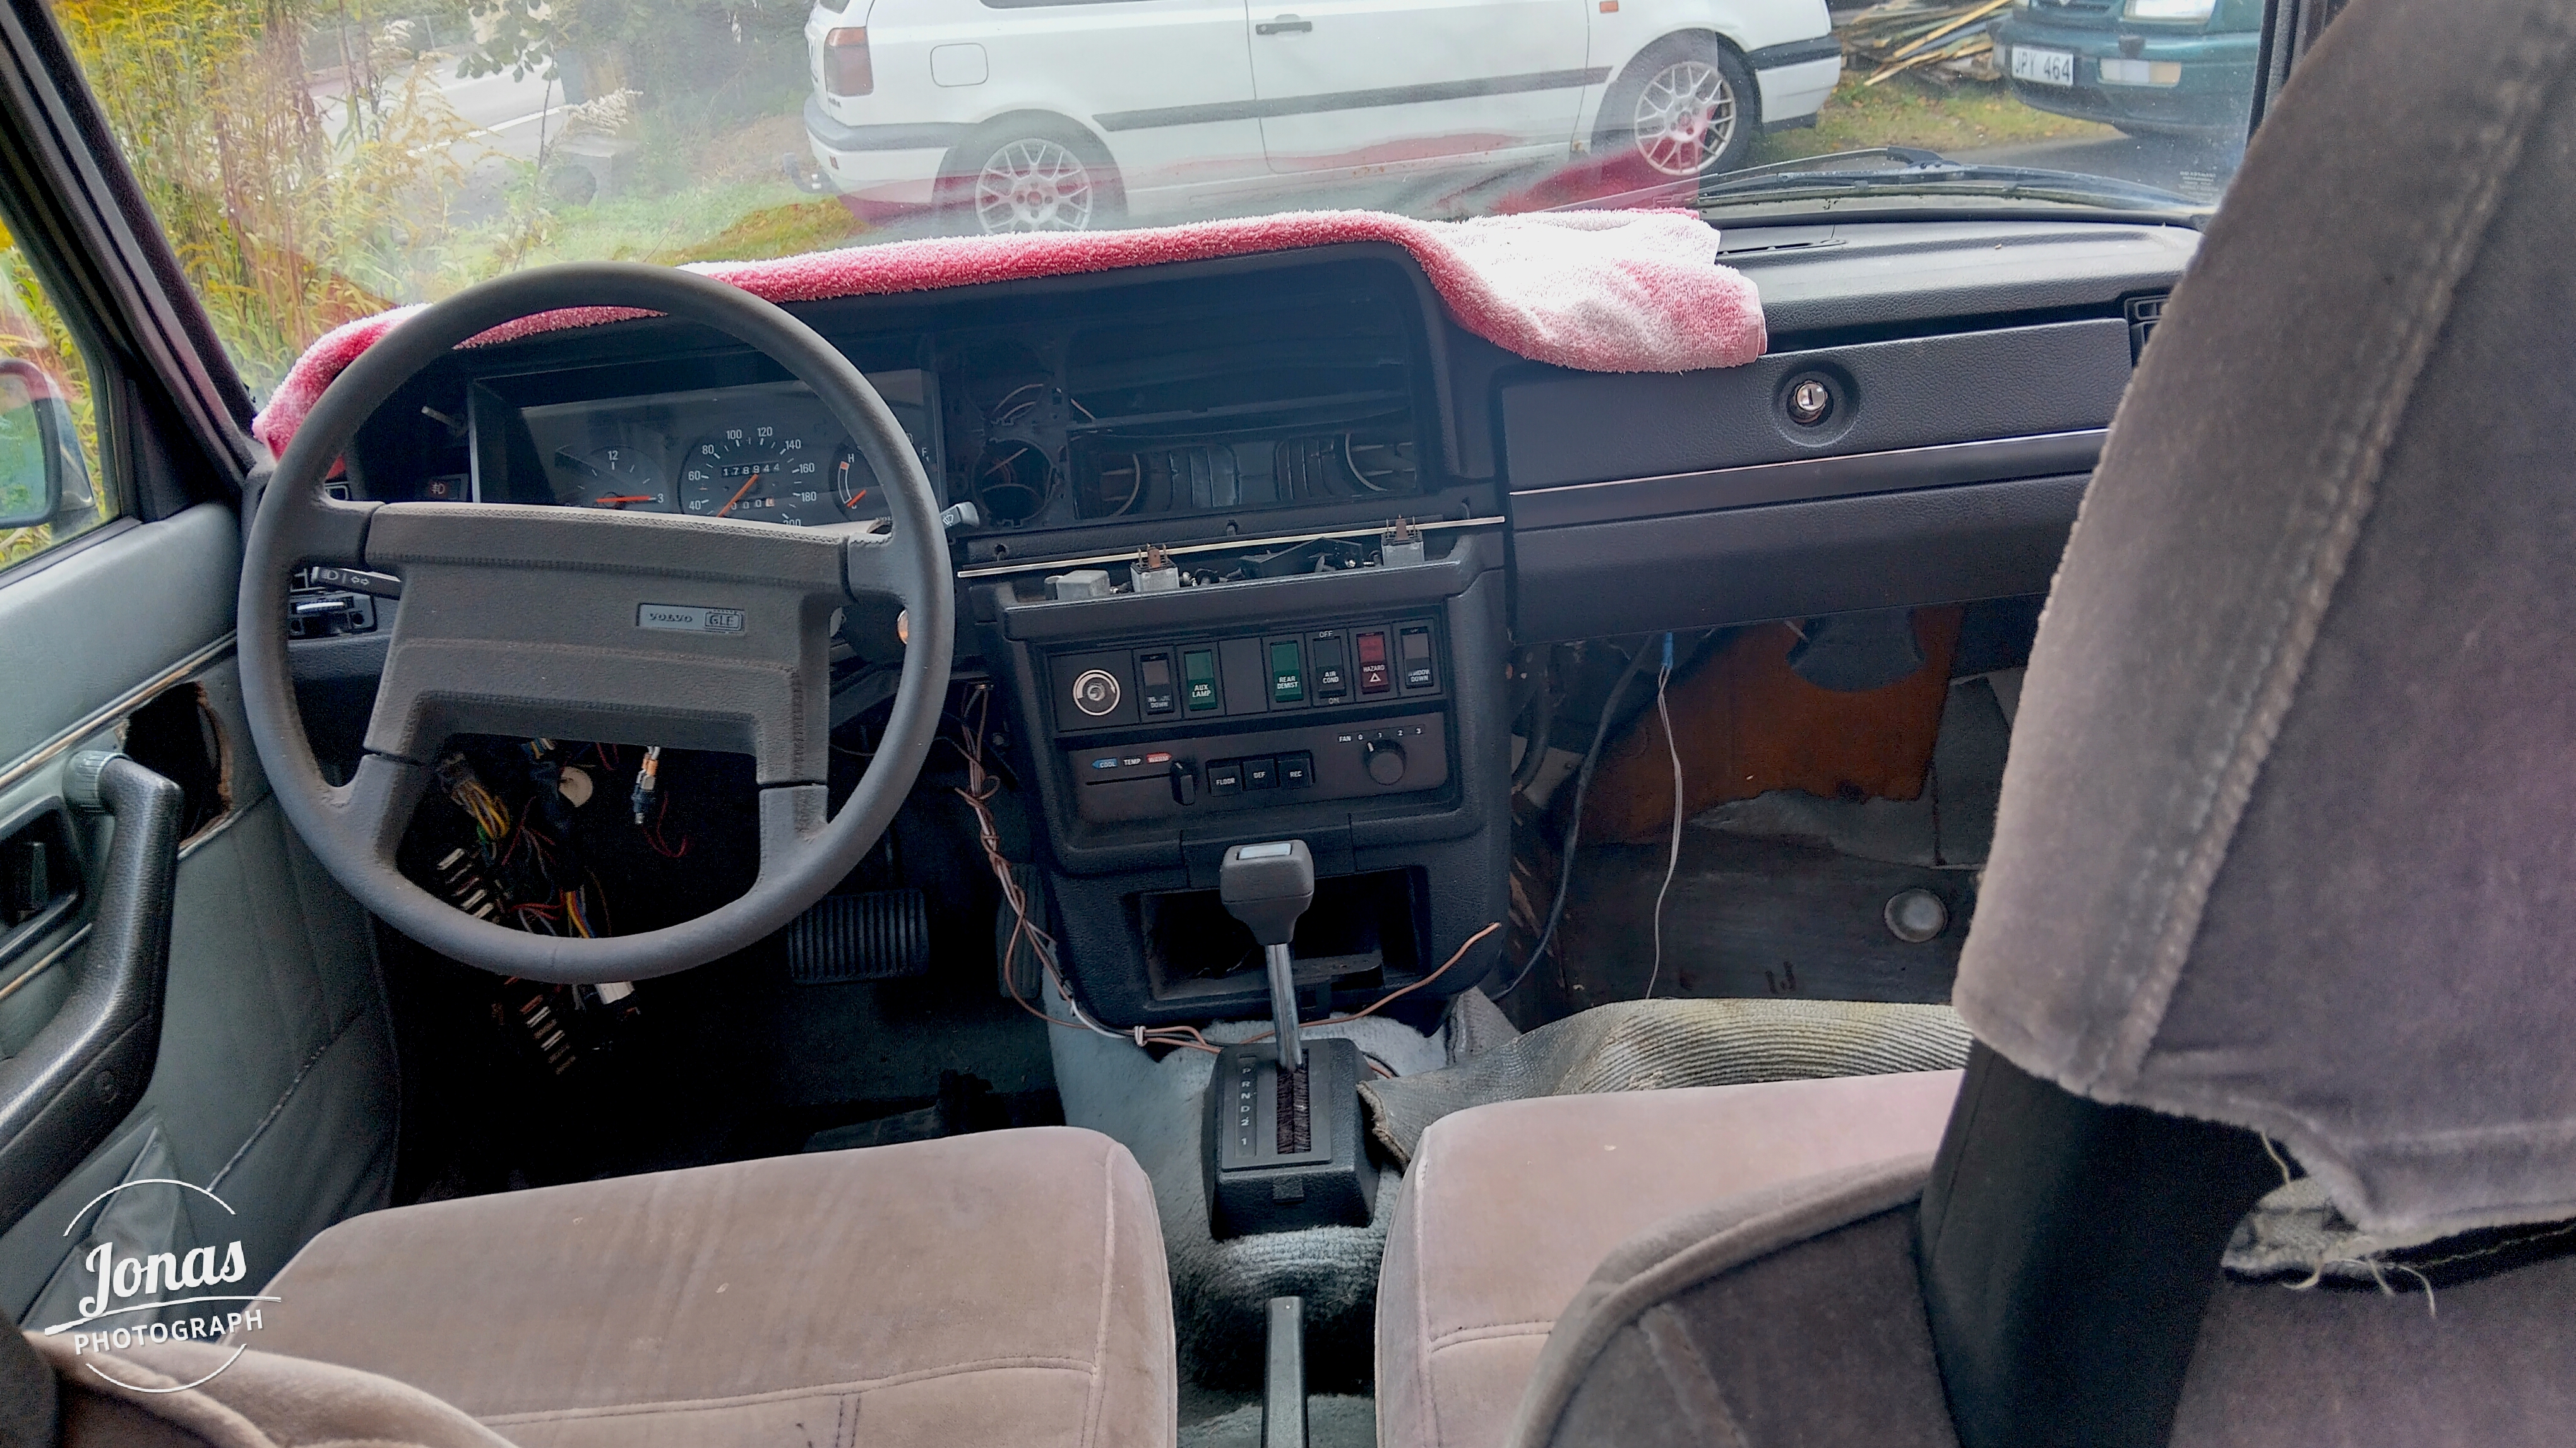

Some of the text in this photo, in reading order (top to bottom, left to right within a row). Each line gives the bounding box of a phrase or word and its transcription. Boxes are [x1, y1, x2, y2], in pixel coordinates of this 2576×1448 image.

[2044, 55, 2070, 81] 464
[726, 429, 742, 441] 100
[758, 426, 773, 437] 120
[701, 444, 715, 455] 80
[785, 439, 801, 450] 140
[607, 450, 619, 461] 12
[848, 453, 855, 463] H
[799, 463, 815, 474] 160
[688, 471, 701, 481] 60
[657, 493, 664, 503] 3
[801, 492, 817, 502] 180
[689, 501, 701, 511] 40
[1216, 777, 1236, 786] FLOOR
